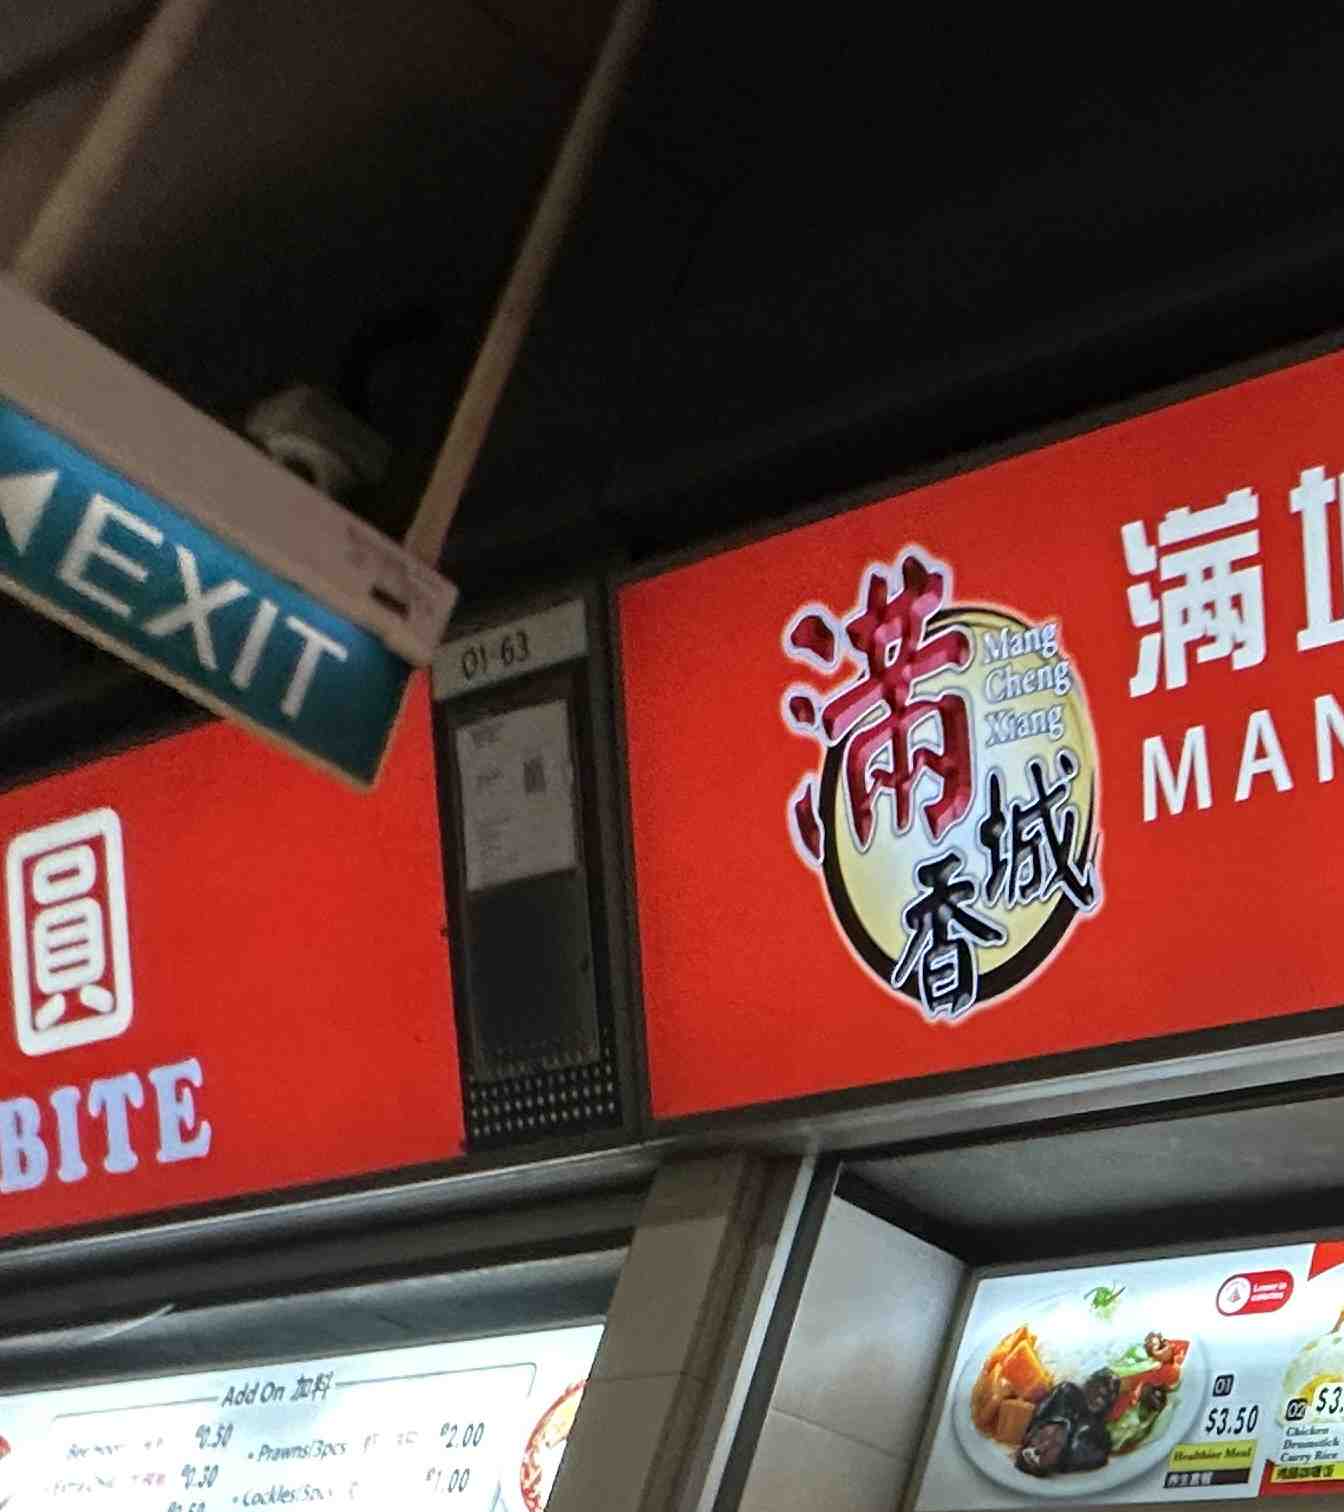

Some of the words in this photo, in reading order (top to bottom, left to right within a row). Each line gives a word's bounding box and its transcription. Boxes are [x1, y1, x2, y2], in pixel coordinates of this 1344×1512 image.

[57, 493, 348, 720] EXIT
[983, 623, 1058, 665] Mang
[984, 660, 1073, 704] Cheng
[984, 703, 1065, 748] Xiang
[0, 1058, 212, 1193] BITE
[221, 1384, 259, 1407] Add
[260, 1381, 285, 1403] On
[1214, 1376, 1233, 1393] 01
[1205, 1404, 1260, 1436] $3.50
[1280, 1452, 1313, 1464] Curry
[1314, 1450, 1339, 1460] Rice
